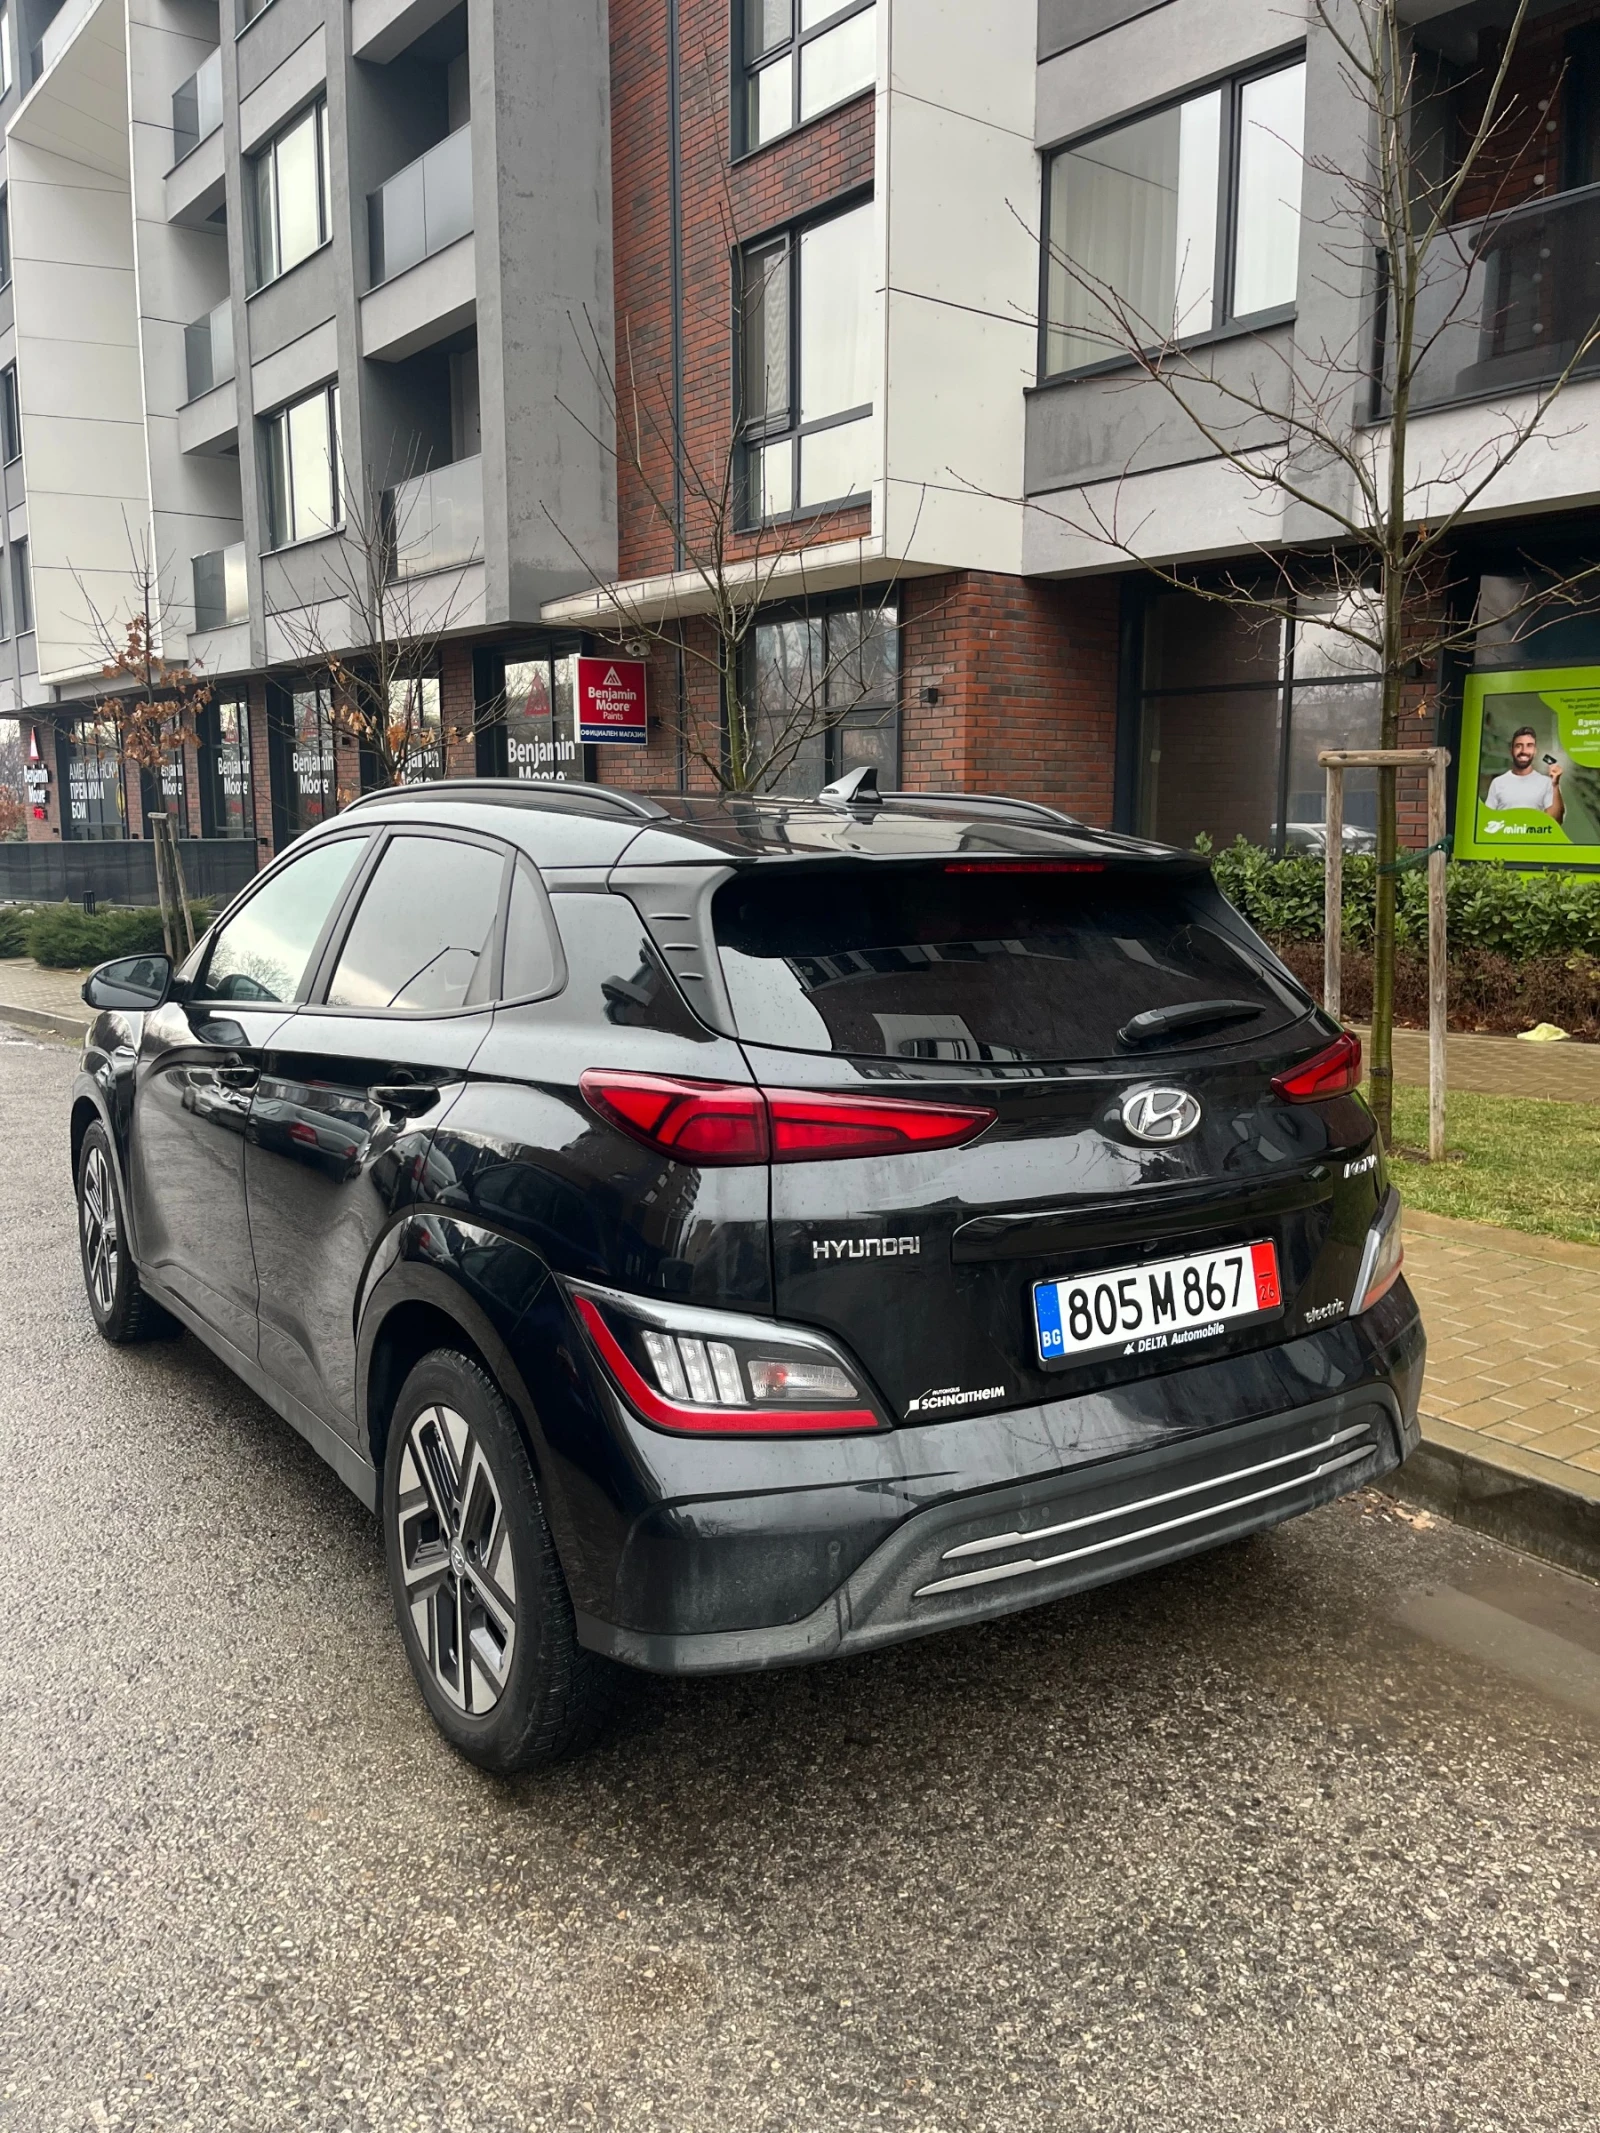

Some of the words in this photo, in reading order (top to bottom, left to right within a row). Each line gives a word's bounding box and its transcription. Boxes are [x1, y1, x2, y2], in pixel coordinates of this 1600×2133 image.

[588, 687, 637, 701] Benjamin
[596, 699, 631, 712] Moore
[603, 712, 624, 721] Paints
[580, 729, 619, 737] ОФИЦИАЛЕН
[619, 730, 646, 738] МАГАЗИН
[508, 733, 576, 768] Benjamin
[293, 750, 334, 777] Benjamin
[70, 781, 105, 799] ПРЕМИУМ
[224, 776, 248, 795] Moore
[300, 774, 330, 794] Moore
[71, 801, 87, 819] БОИ
[1503, 822, 1553, 835] minimart
[812, 1236, 921, 1259] HYUNDAI
[1068, 1277, 1143, 1341] 805
[1148, 1270, 1177, 1325] M
[1183, 1257, 1244, 1316] 867
[1259, 1284, 1276, 1300] 26
[1304, 1298, 1345, 1324] electric
[1042, 1330, 1062, 1347] BG
[1138, 1337, 1168, 1353] DELTA
[1171, 1322, 1225, 1346] Automobile
